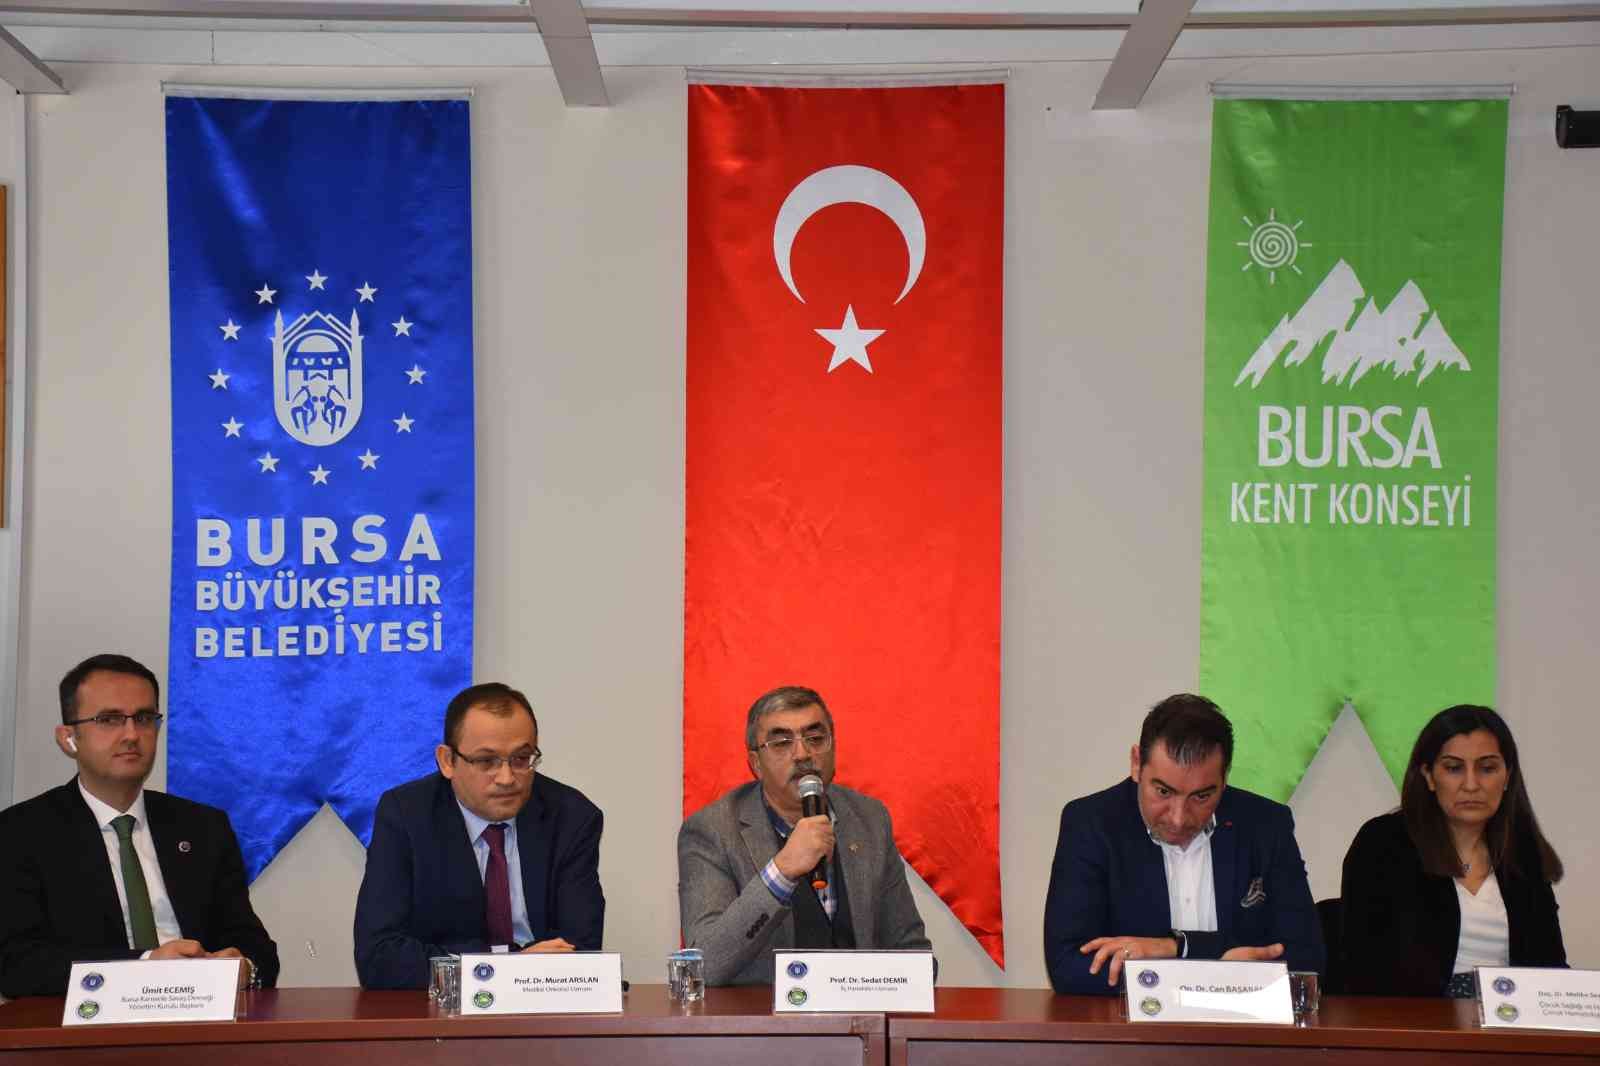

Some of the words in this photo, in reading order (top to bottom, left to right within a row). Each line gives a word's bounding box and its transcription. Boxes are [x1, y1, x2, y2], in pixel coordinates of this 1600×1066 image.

[1258, 405, 1442, 469] BURSA
[1231, 482, 1319, 524] KENT
[1329, 474, 1472, 527] KONSEYİ
[196, 513, 442, 567] BURSA
[196, 565, 441, 613] BÜYÜKŞEHİR
[195, 611, 442, 658] BELEDİYESİ
[142, 985, 162, 994] Ümit
[545, 976, 567, 984] Murat
[568, 976, 599, 984] ARSLAN
